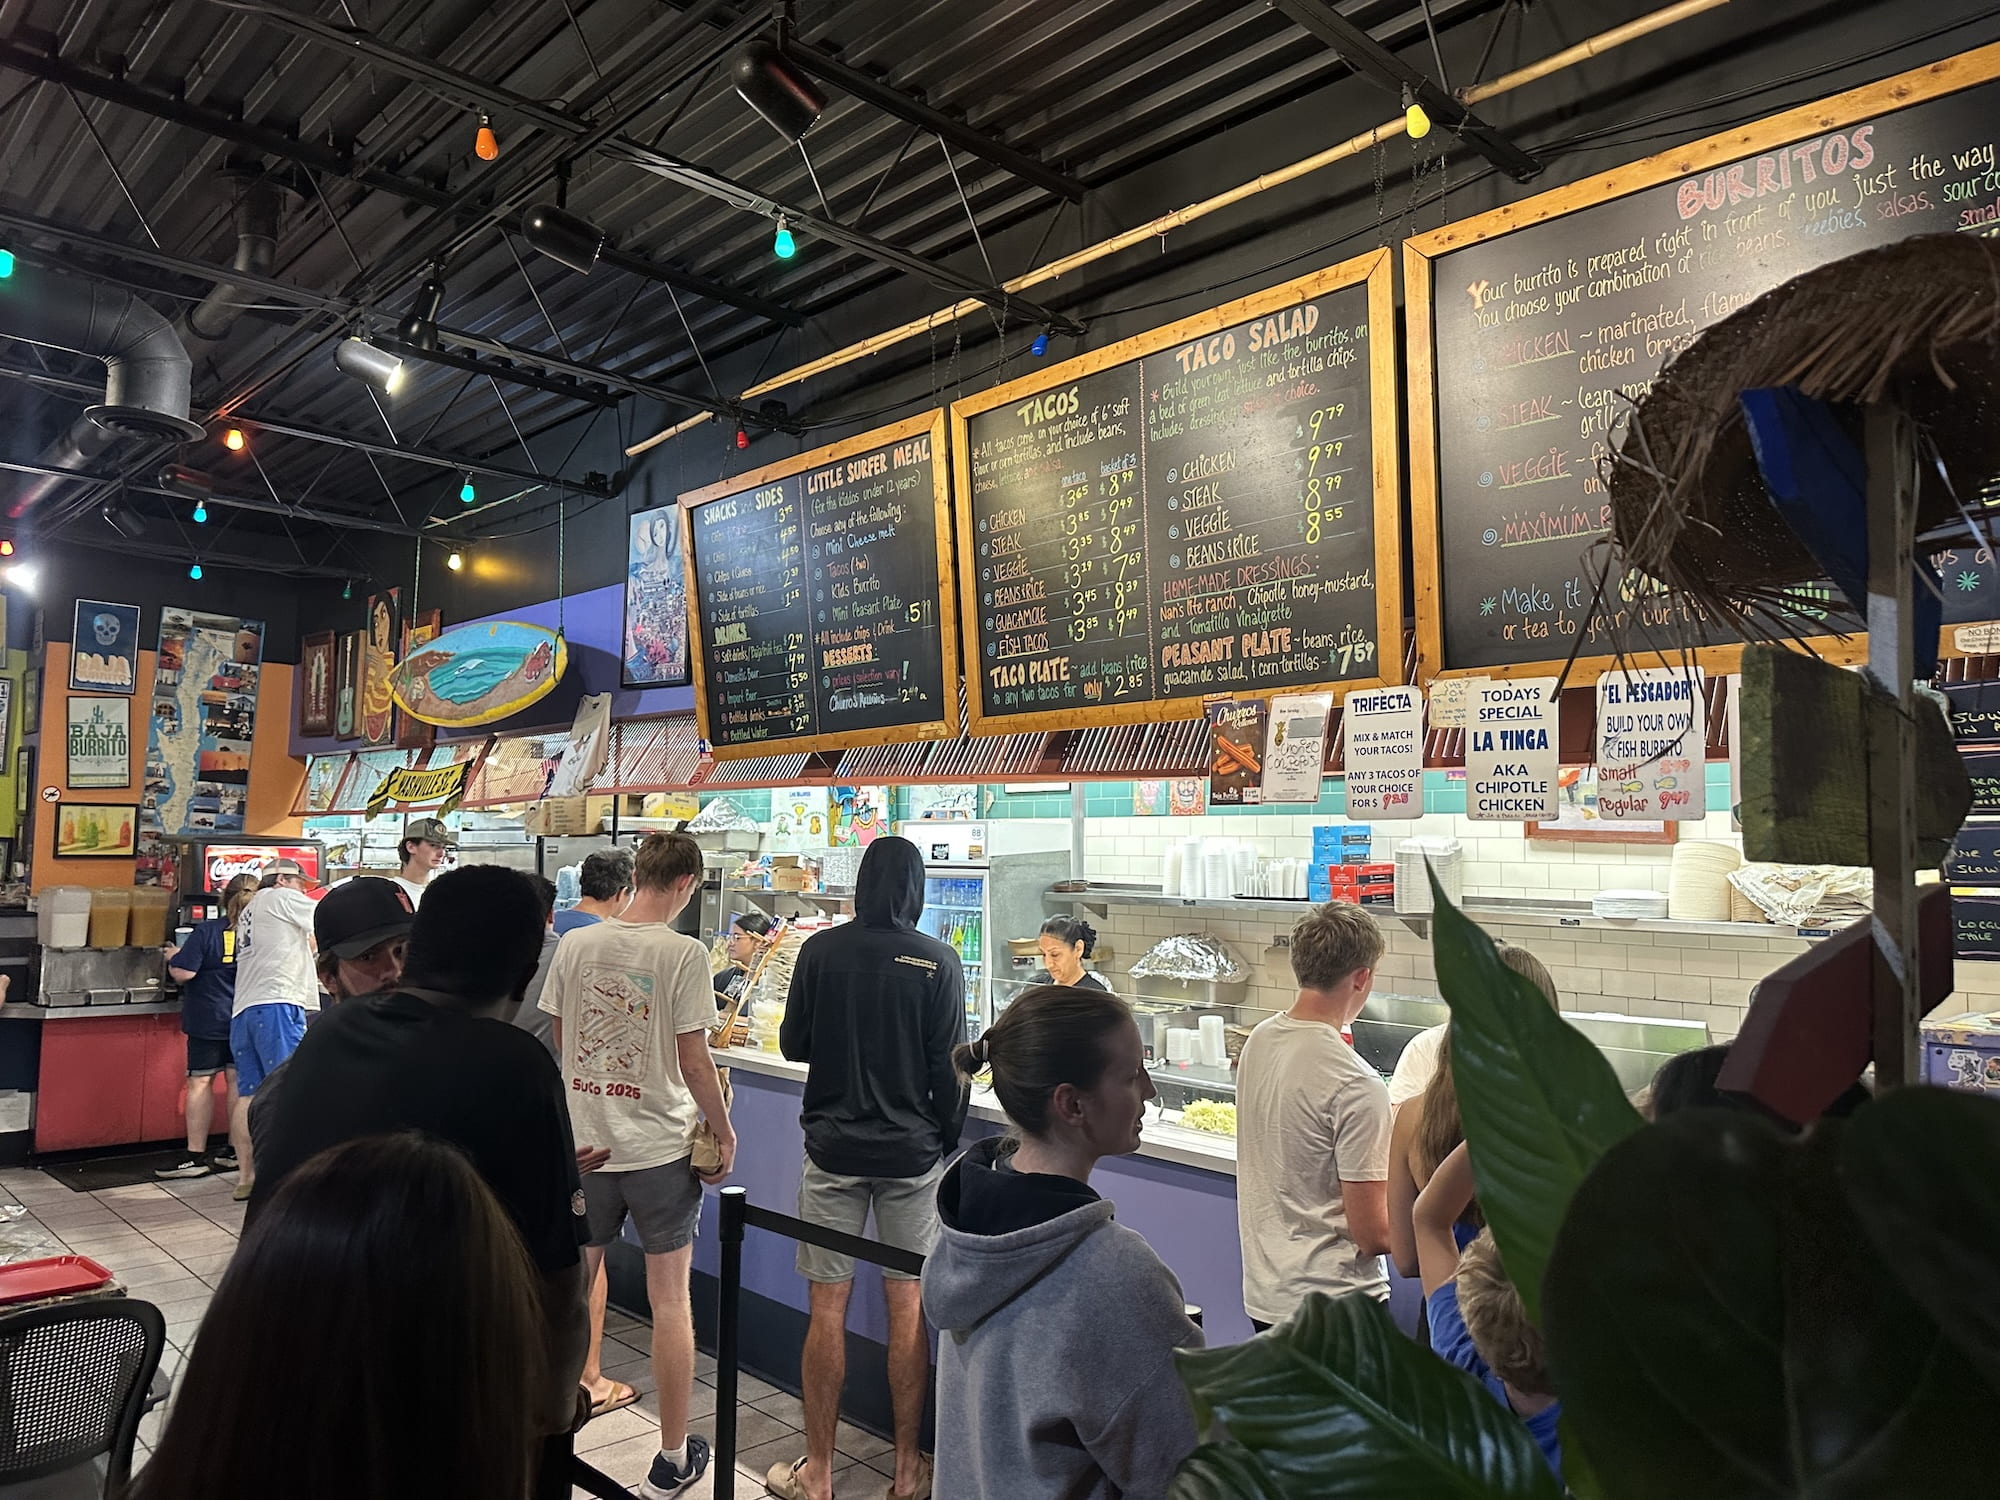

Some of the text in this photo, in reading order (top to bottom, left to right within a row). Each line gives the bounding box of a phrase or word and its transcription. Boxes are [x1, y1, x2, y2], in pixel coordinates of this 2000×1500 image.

[1676, 125, 1874, 220] BURRITOS
[1466, 143, 1994, 310] Your burrito is prepared right in front of you just the way
[1474, 191, 1934, 328] You choose your combination of salsas,
[1598, 299, 1694, 344] marinated,
[1176, 305, 1319, 375] TACO SALAD
[1163, 324, 1367, 400] Build just like the burritos, on
[1579, 349, 1635, 374] chicken
[1149, 348, 1357, 425] a bed and tortilla chips.
[1017, 386, 1079, 427] TACOS
[1150, 380, 1320, 441] Includes choice.
[982, 397, 1130, 457] All tacos come on your choice of soft
[973, 422, 1126, 477] flour corn and include beans,
[807, 439, 930, 495] LITTLE SURFER MEAL
[839, 470, 920, 508] kiddos under 12 years)
[1182, 481, 1222, 510] STEAK
[704, 486, 783, 525] SNACKS SIDES
[810, 511, 868, 538] Choose any the
[847, 523, 895, 549] Cheese melt
[991, 533, 1021, 556] STEAK
[1186, 544, 1225, 568] BEANS
[827, 554, 869, 579] Tacos (two)
[832, 573, 880, 599] Kids Burrito
[994, 587, 1020, 606] BEANS
[1160, 569, 1374, 621] Nan's Chipotle honey-mustard,
[1164, 570, 1231, 599] HOME-MADE
[1501, 584, 1554, 614] Make
[1565, 577, 1581, 609] it
[852, 594, 902, 618] Peasant Plate
[996, 606, 1046, 630] GUACAMOLE
[715, 623, 747, 644] DRINKS
[831, 625, 870, 643] include chips
[1161, 612, 1230, 639] and Tomatillo
[1504, 611, 1575, 640] or tea to
[1023, 632, 1048, 651] TACOS
[1162, 627, 1337, 668] PEASANT PLATE beans,
[990, 654, 1148, 689] TACO PLATE add beans rice
[1217, 653, 1319, 681] salad, corn tortillas
[993, 678, 1102, 708] to any two tacos for only
[1353, 694, 1412, 713] TRIFECTA
[1481, 688, 1540, 702] TODAYS
[1217, 705, 1256, 726] Churros
[1480, 705, 1542, 719] SPECIAL
[1607, 716, 1633, 733] BUILD
[1637, 714, 1664, 731] YOUR
[70, 724, 125, 738] BAJA
[1354, 731, 1413, 742] MIX & MATCH
[1473, 729, 1548, 751] LA TINGA
[70, 739, 126, 756] BURRITO
[1355, 745, 1413, 756] YOUR TACOS!
[1618, 741, 1636, 758] FISH
[1348, 769, 1420, 780] ANY 3 TACOS OF
[1493, 765, 1528, 776] AKA
[1600, 764, 1636, 780] small
[1352, 784, 1413, 793] YOUR CHOICE
[1476, 781, 1547, 794] CHIPOTLE
[1353, 799, 1370, 807] FOR
[1479, 799, 1544, 811] CHICKEN
[1599, 795, 1648, 816] regular
[606, 1083, 641, 1100] 2025
